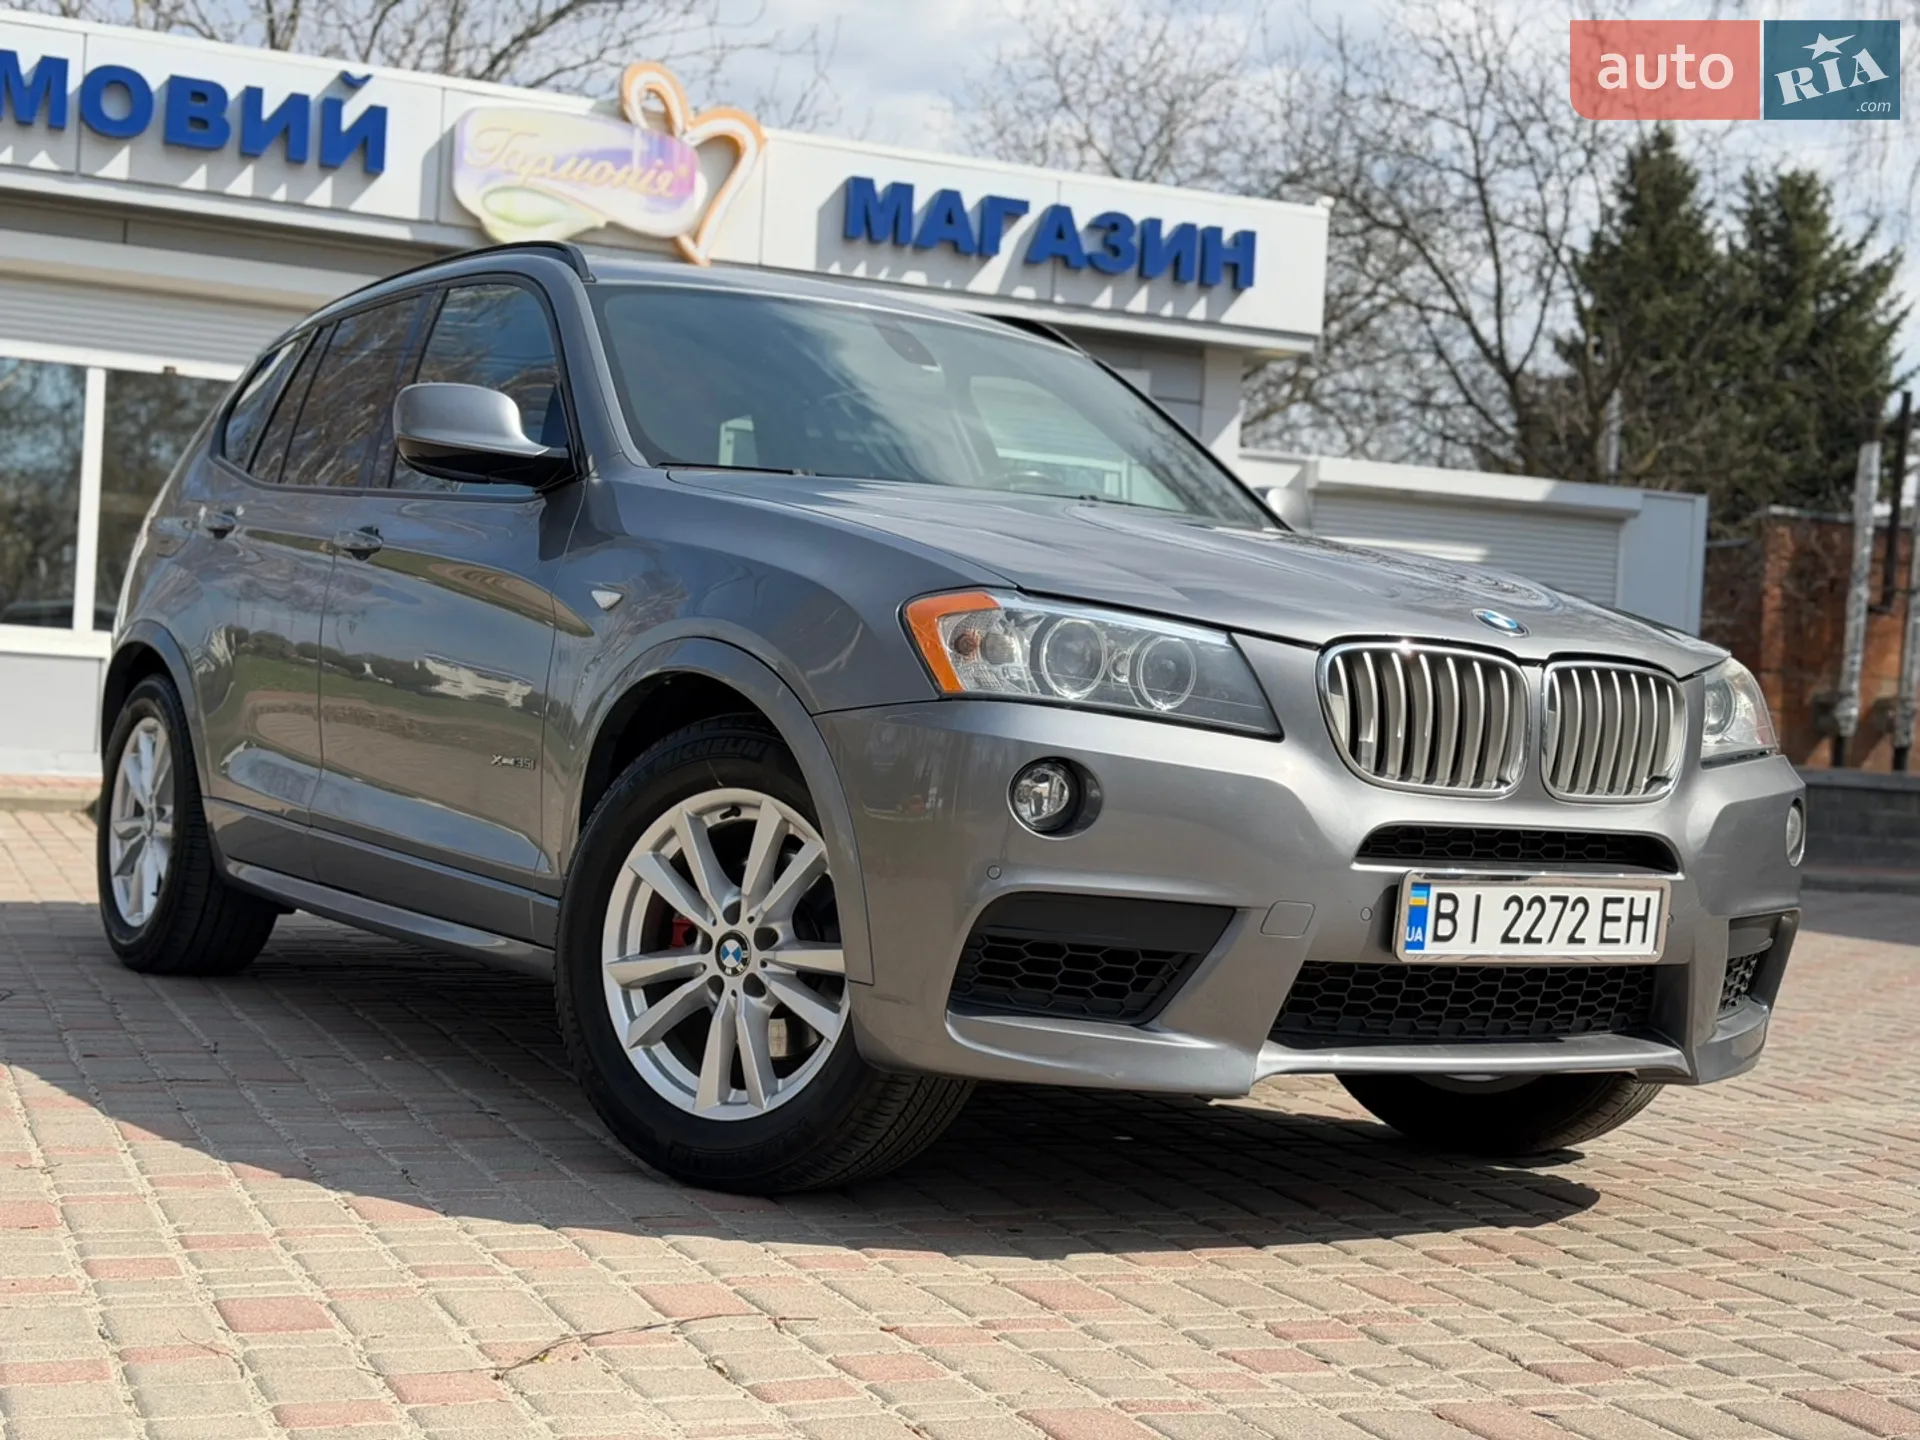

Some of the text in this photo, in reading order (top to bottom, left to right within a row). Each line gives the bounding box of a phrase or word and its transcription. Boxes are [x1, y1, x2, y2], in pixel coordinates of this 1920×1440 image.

[842, 175, 1257, 290] МАГАЗИН
[1405, 925, 1424, 942] UA
[1431, 891, 1652, 946] BI 2272 EH
